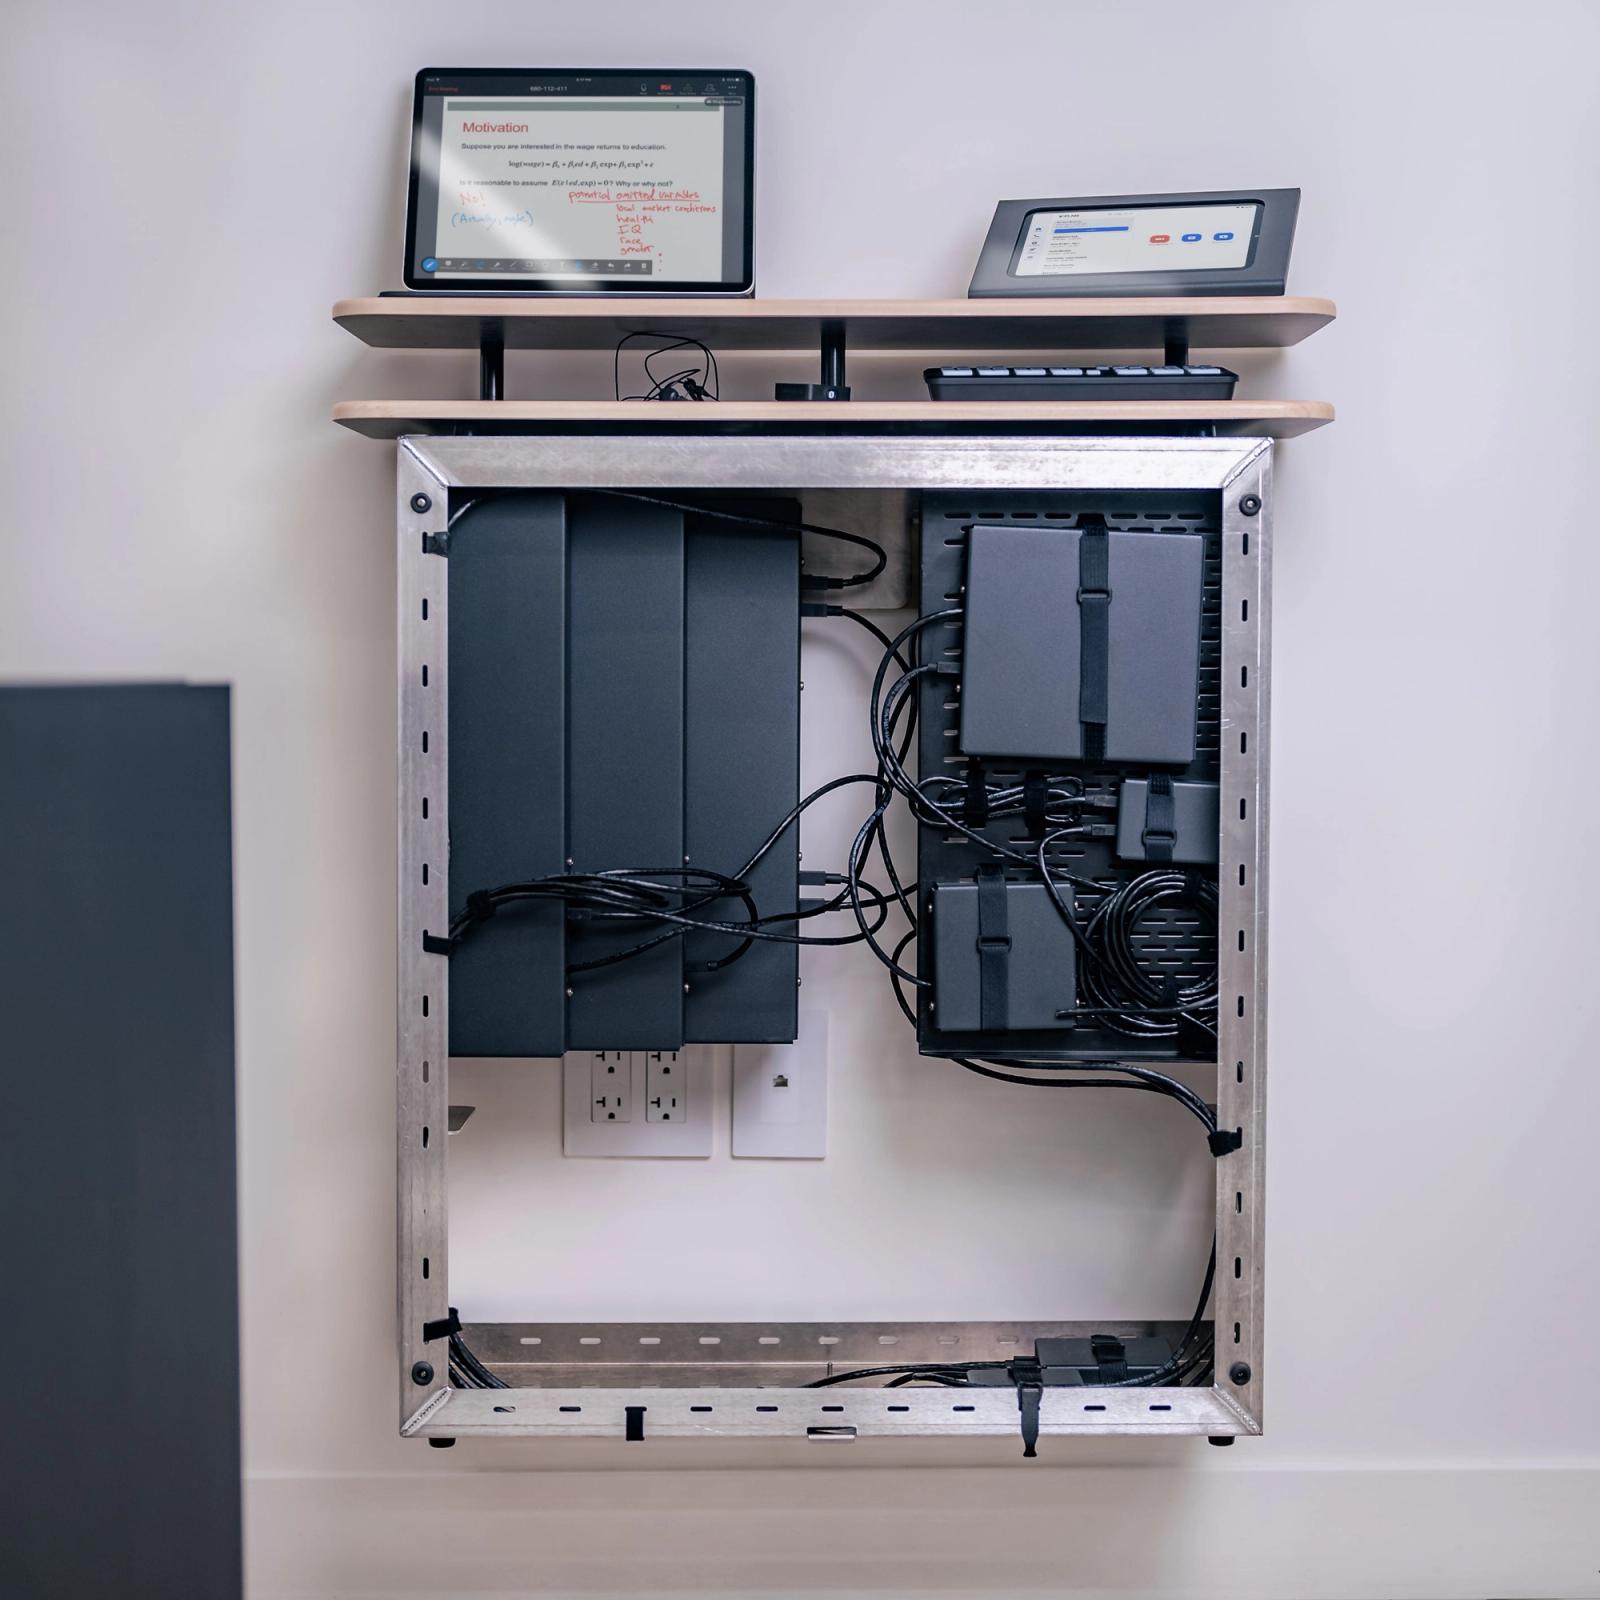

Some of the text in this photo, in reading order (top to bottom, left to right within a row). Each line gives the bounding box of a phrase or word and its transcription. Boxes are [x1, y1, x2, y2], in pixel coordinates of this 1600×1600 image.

[463, 122, 529, 133] Motivation
[461, 143, 492, 151] Suppose
[631, 143, 666, 151] education.
[615, 180, 631, 188] Why
[675, 203, 716, 213] conditions
[616, 214, 653, 224] health
[620, 244, 656, 255] gender
